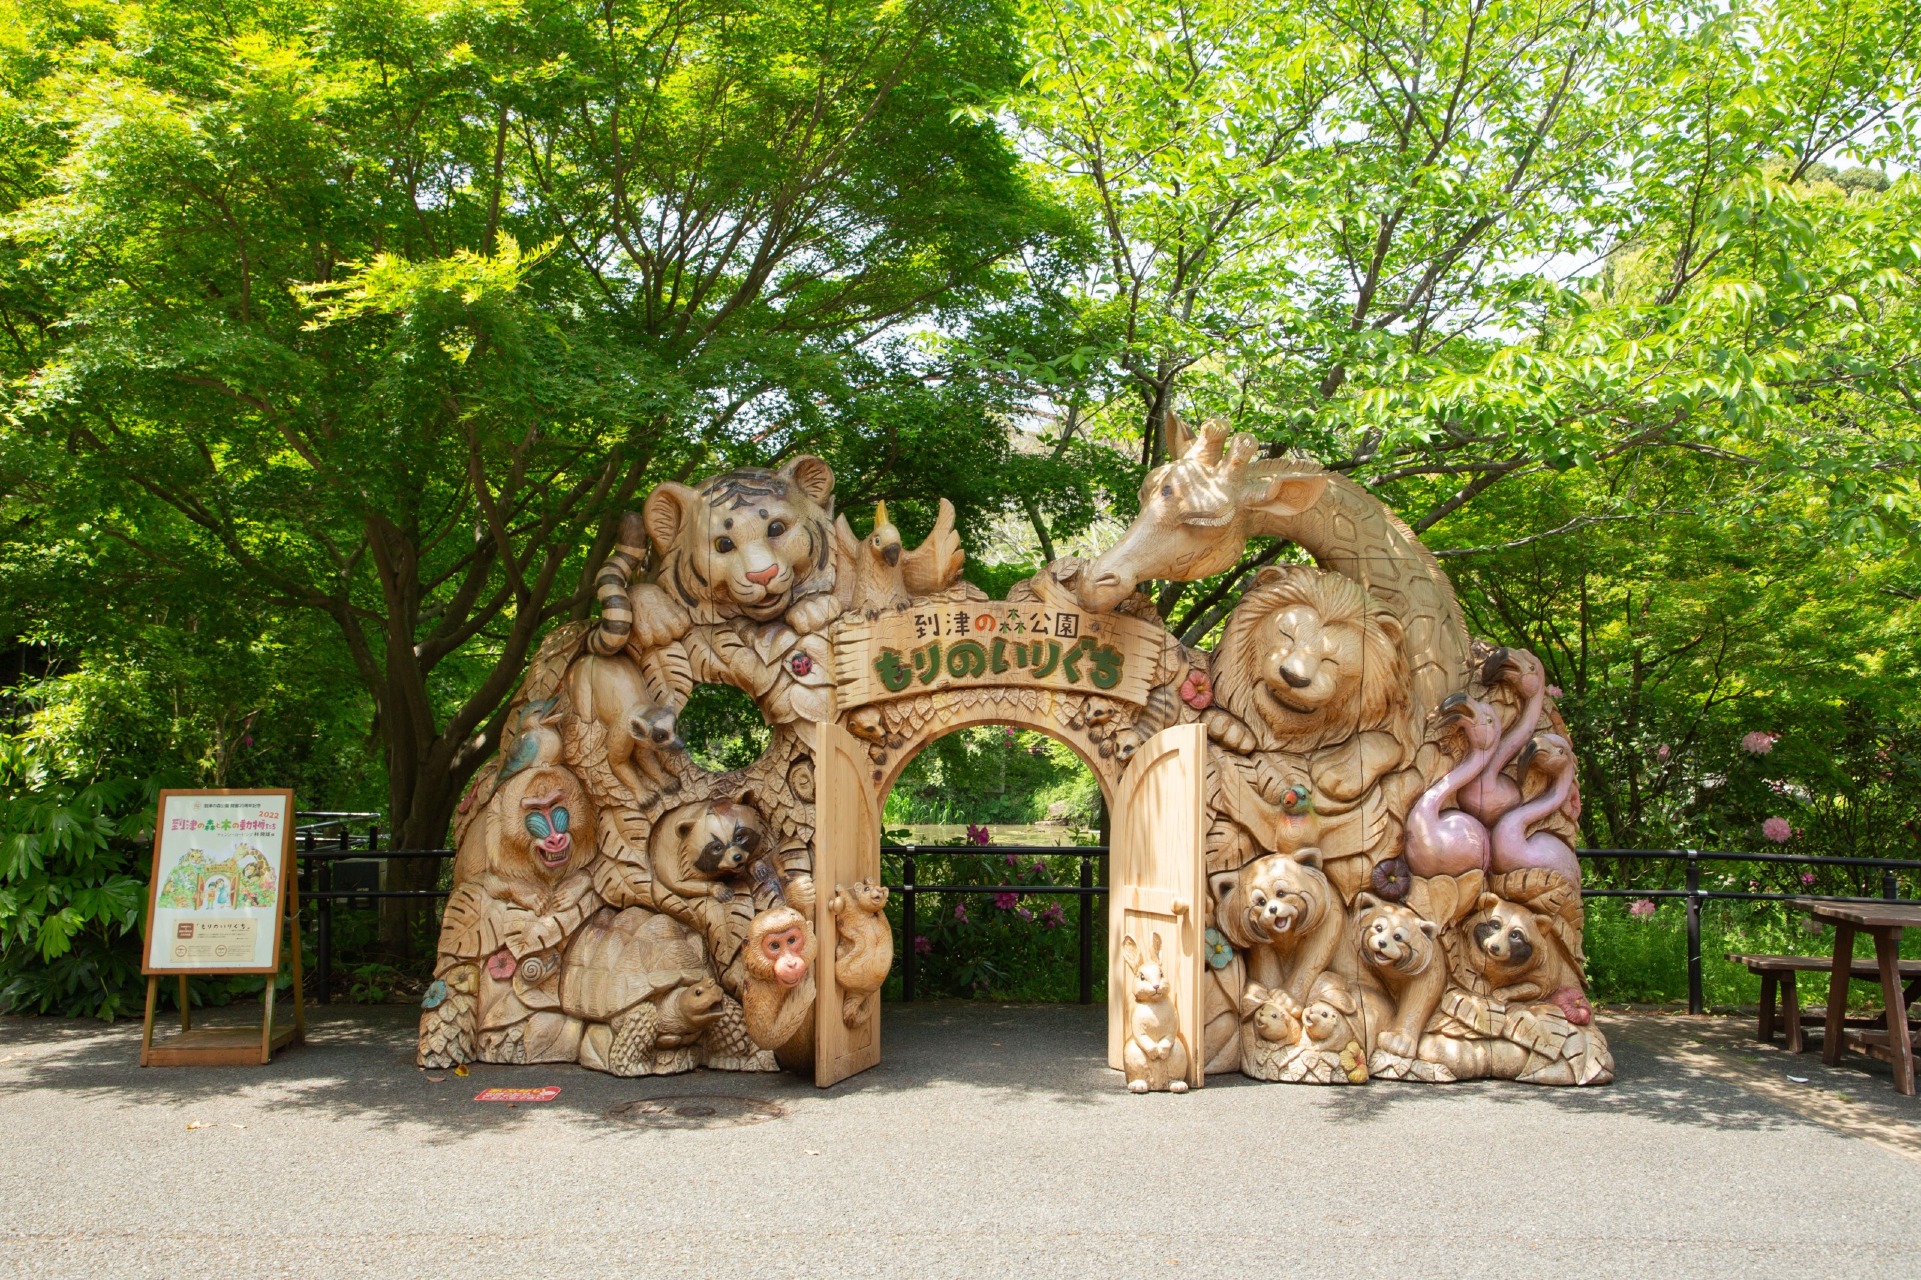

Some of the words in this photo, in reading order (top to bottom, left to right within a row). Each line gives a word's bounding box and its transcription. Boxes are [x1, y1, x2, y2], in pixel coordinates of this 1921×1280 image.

[914, 608, 1079, 638] 到津の森公園
[874, 637, 1124, 691] もりのいりぐち
[258, 810, 279, 819] 2022
